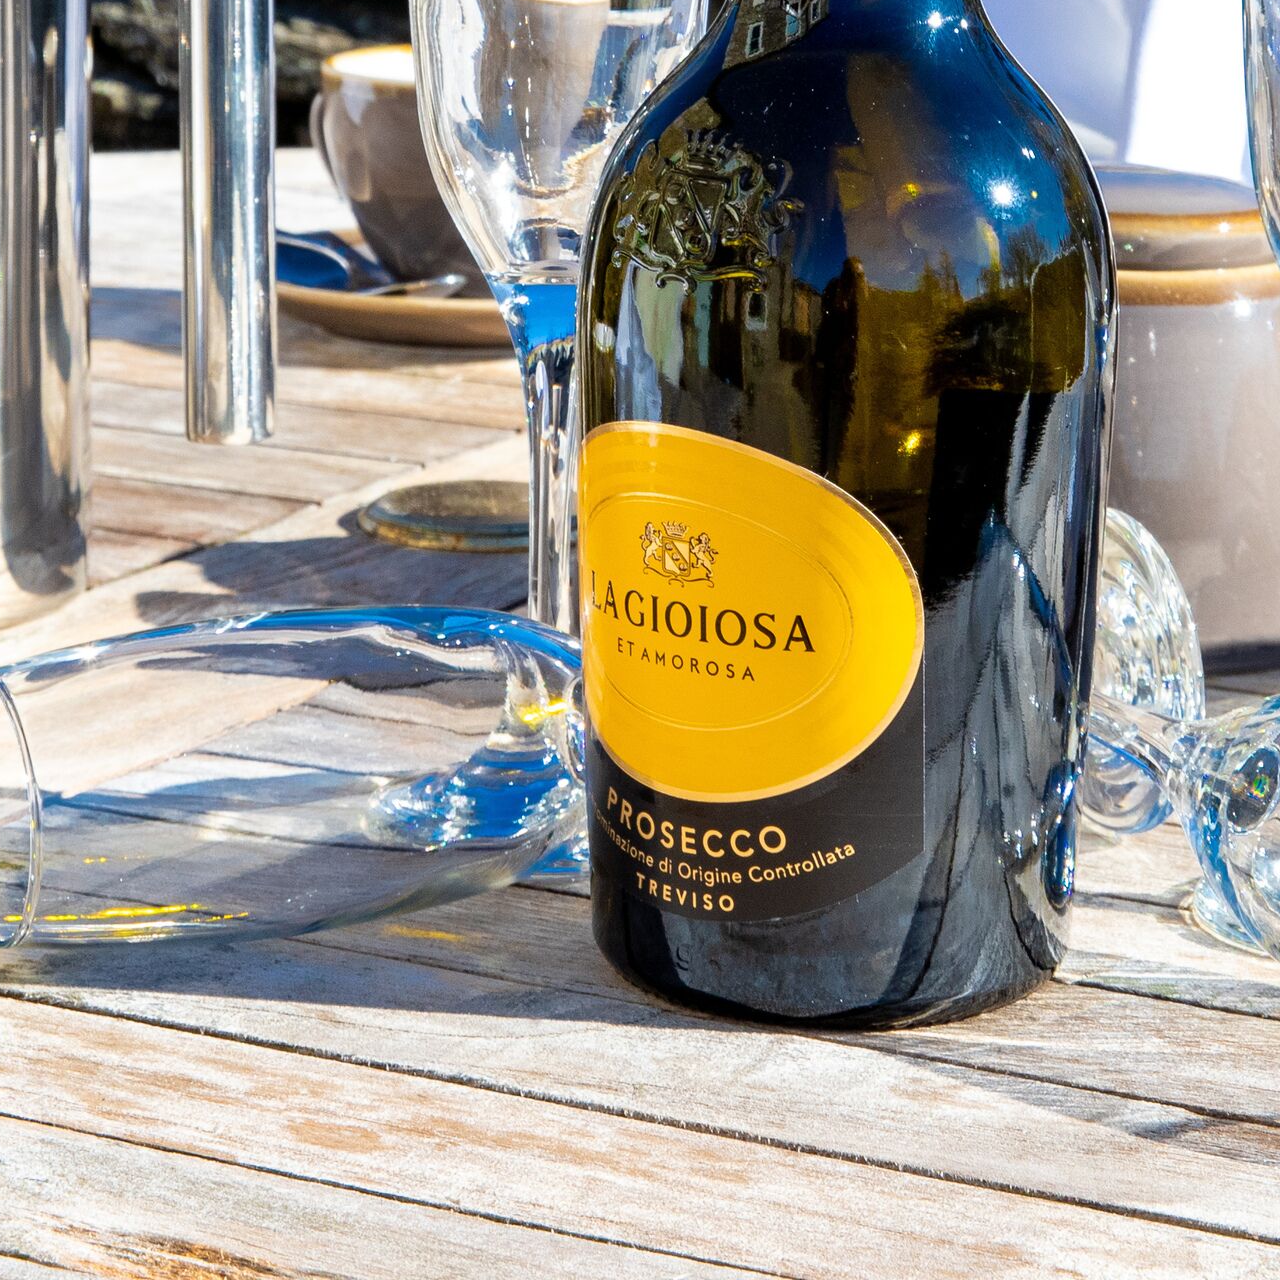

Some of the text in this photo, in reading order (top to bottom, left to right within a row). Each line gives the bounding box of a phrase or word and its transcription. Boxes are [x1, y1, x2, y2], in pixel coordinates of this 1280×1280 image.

[593, 800, 856, 888] ominazione di Origine Controllata
[606, 786, 787, 858] PROSECCO
[636, 871, 735, 912] TREVISO
